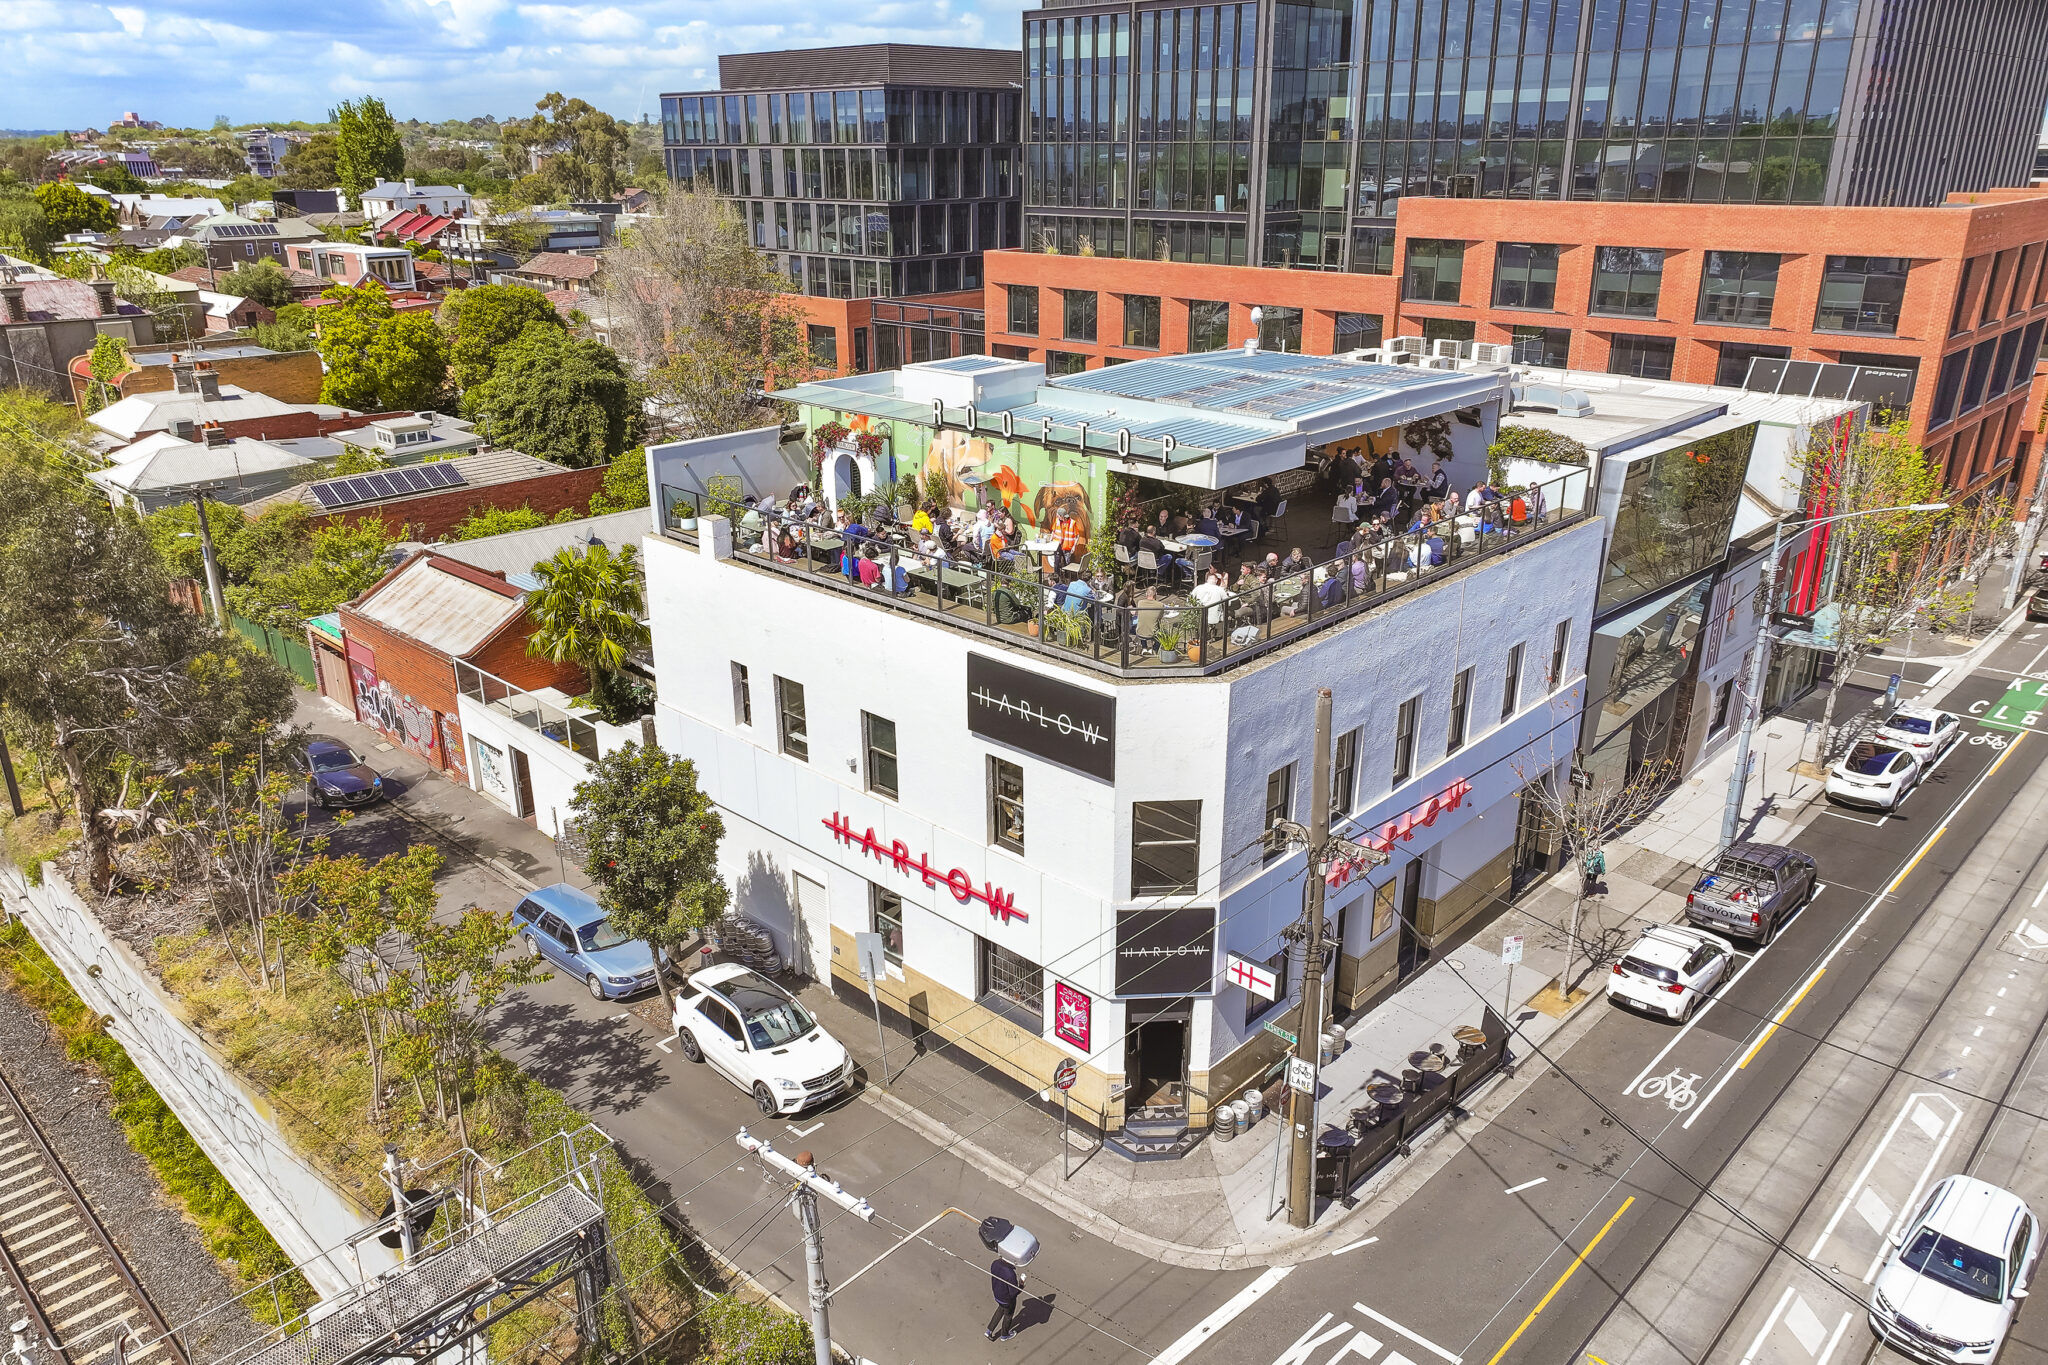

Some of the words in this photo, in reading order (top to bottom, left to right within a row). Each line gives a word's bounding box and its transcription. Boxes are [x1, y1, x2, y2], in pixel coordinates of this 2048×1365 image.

[932, 397, 1176, 464] ROOFTOP
[971, 686, 1109, 745] HARLOW
[821, 811, 1029, 922] HARLOW
[1702, 904, 1741, 921] TOYOTA
[1120, 945, 1210, 958] HARLOW
[1060, 991, 1086, 1009] TRIVIA
[1063, 987, 1083, 1002] DRAG
[1291, 1076, 1311, 1090] LANE
